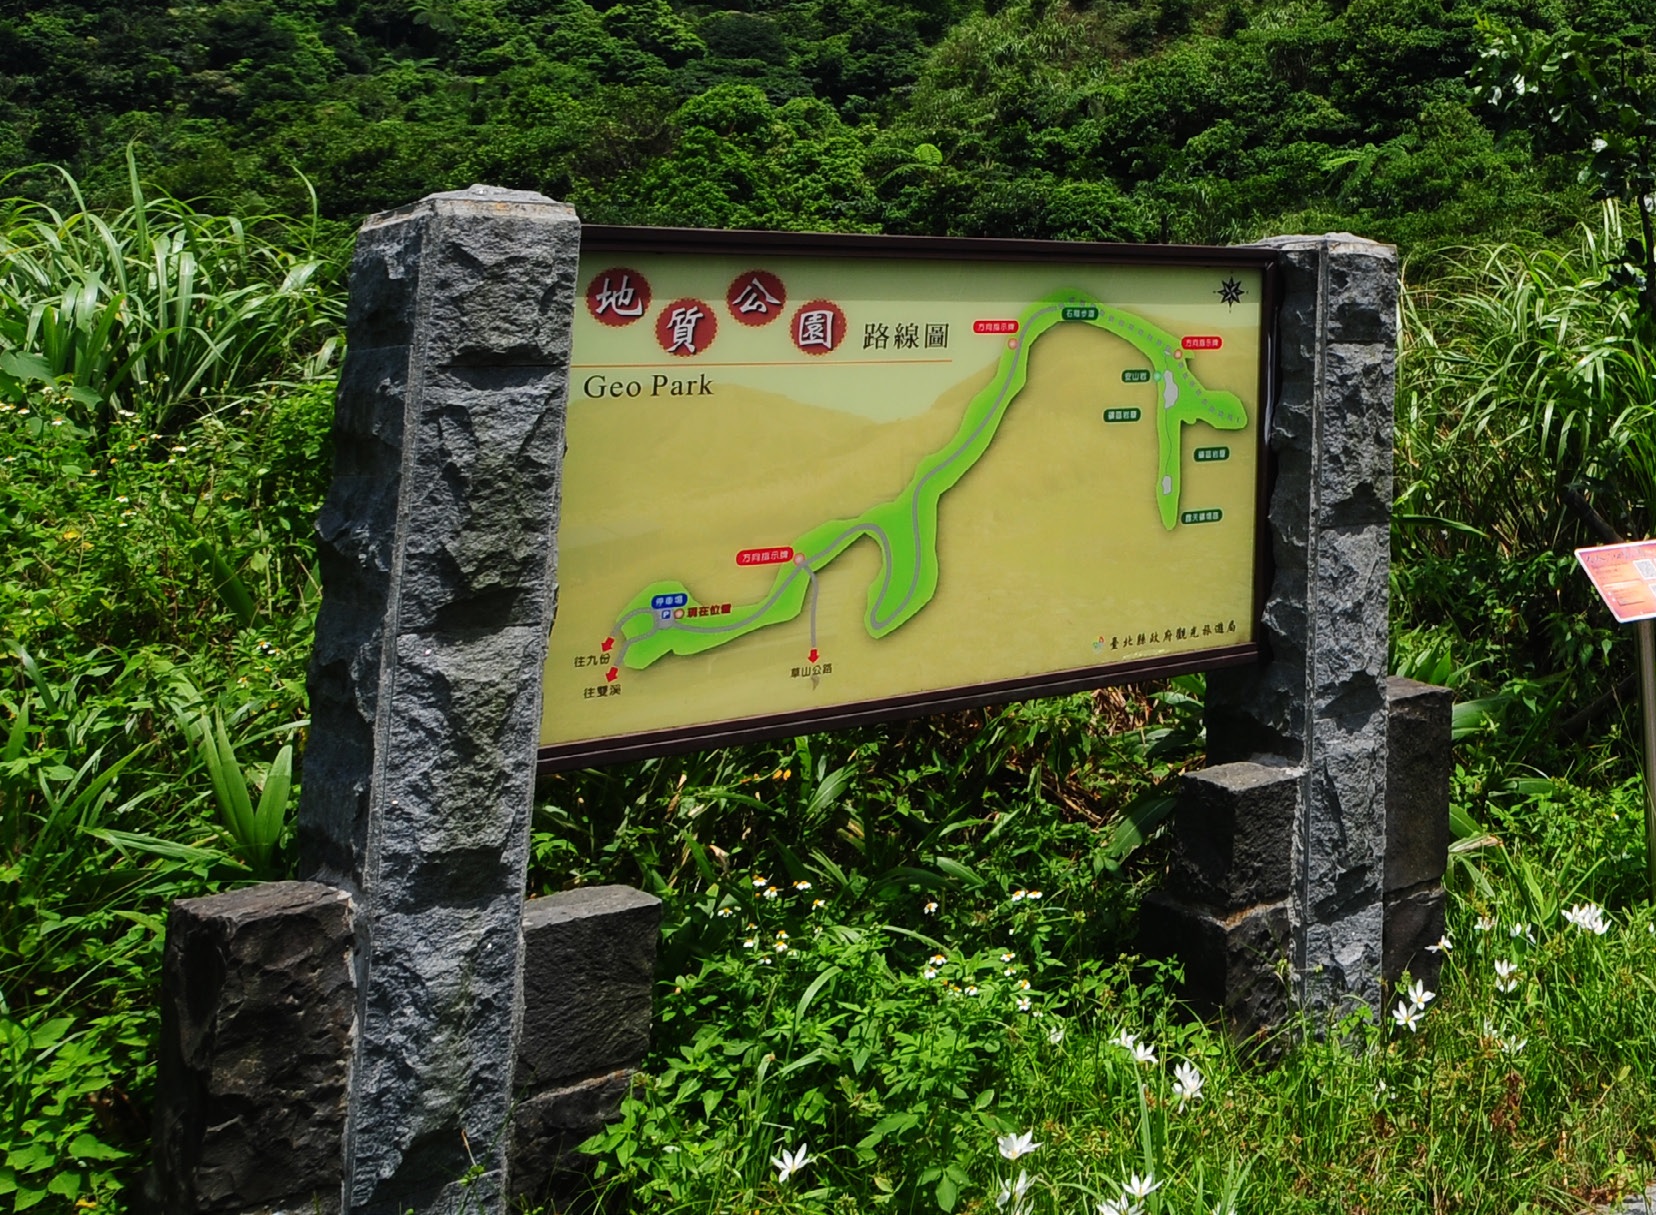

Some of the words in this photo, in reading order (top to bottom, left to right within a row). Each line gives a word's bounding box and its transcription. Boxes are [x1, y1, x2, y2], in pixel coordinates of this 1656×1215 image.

[595, 274, 835, 354] 地質公園
[862, 322, 950, 350] 路線圖
[977, 323, 1016, 332] 方向指示牌
[583, 374, 642, 399] Geo
[650, 374, 715, 397] Park
[741, 549, 790, 564] 方向指示牌
[655, 594, 684, 607] 停車場
[687, 603, 732, 619] 現在位置
[573, 652, 611, 667] 往九份
[790, 663, 833, 678] 草山公路
[583, 683, 622, 699] 往雙溪
